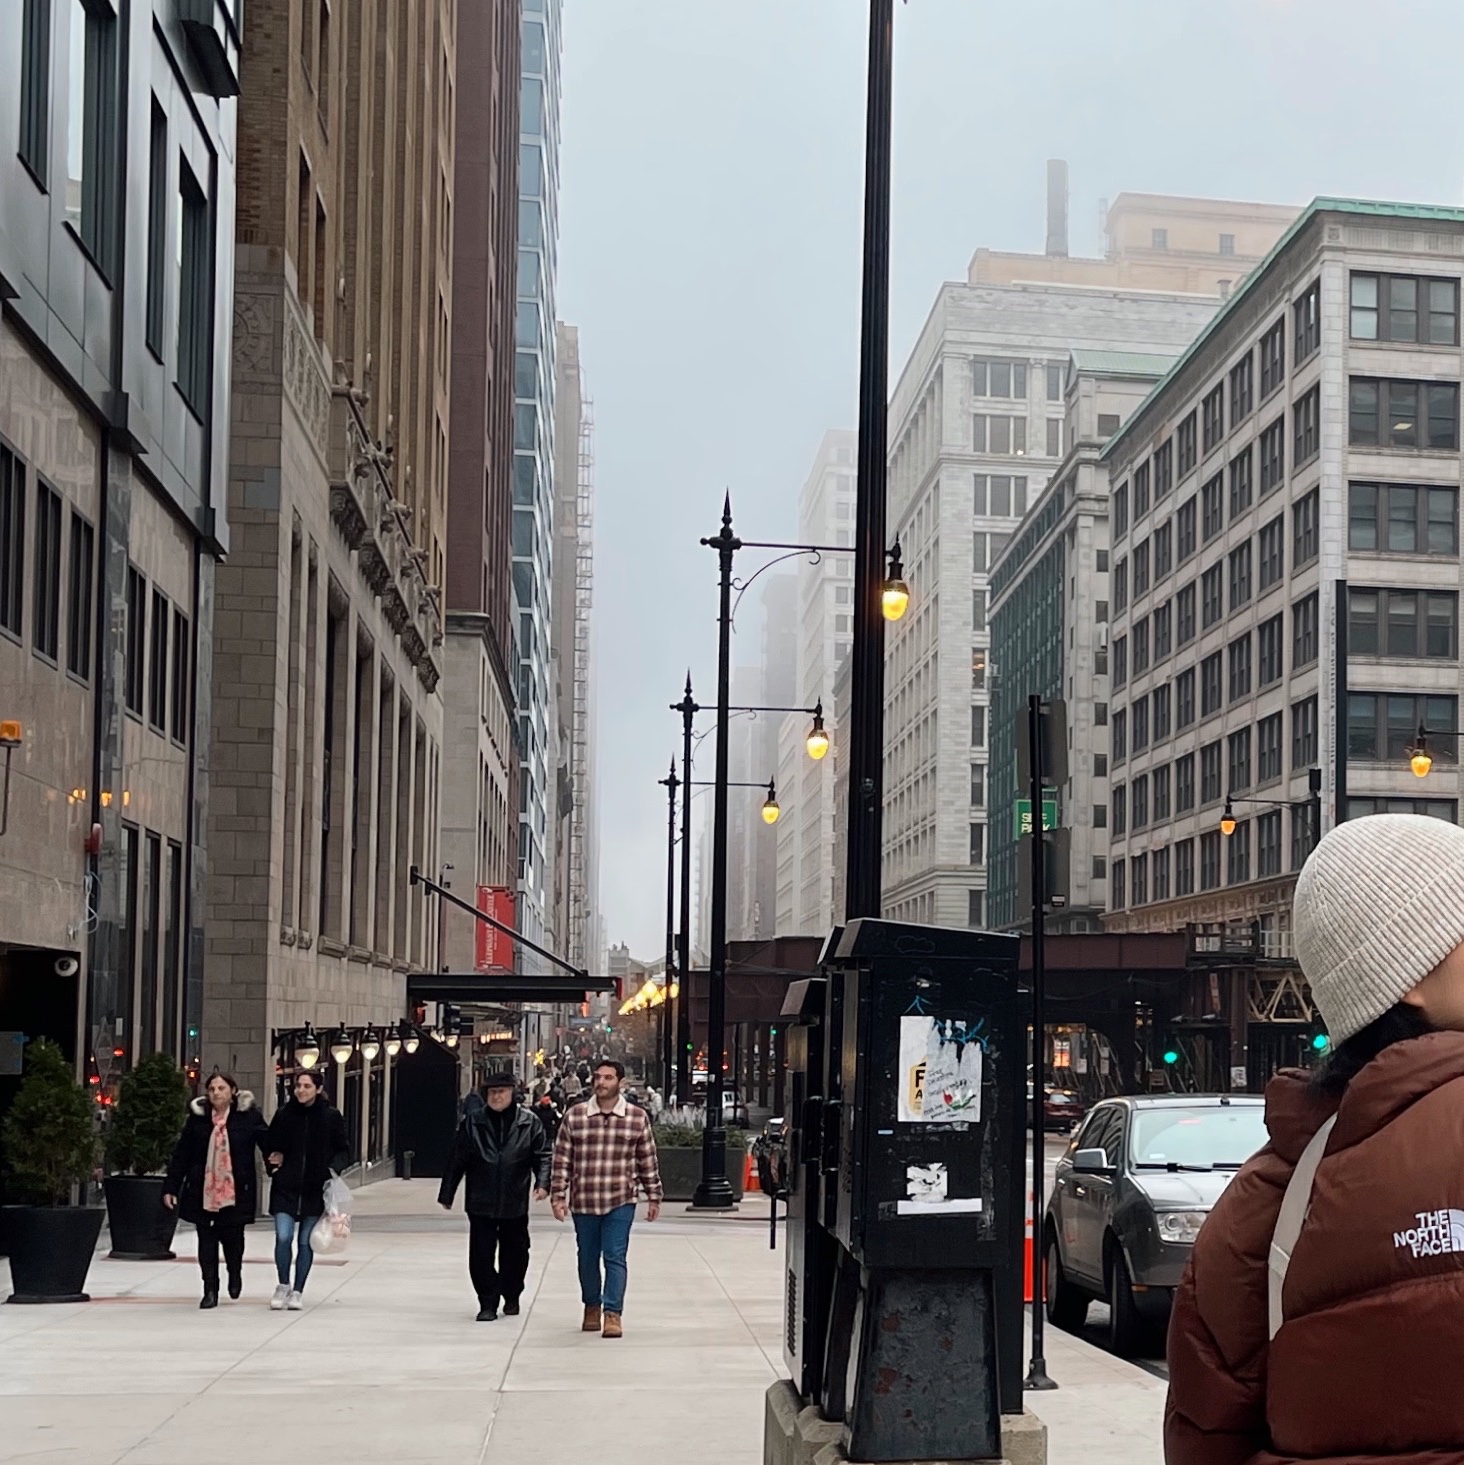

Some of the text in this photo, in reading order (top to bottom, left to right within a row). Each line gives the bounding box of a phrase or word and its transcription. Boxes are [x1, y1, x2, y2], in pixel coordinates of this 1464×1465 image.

[1415, 1209, 1449, 1228] THE
[1393, 1223, 1450, 1248] NORTH
[1411, 1238, 1452, 1258] FACE
